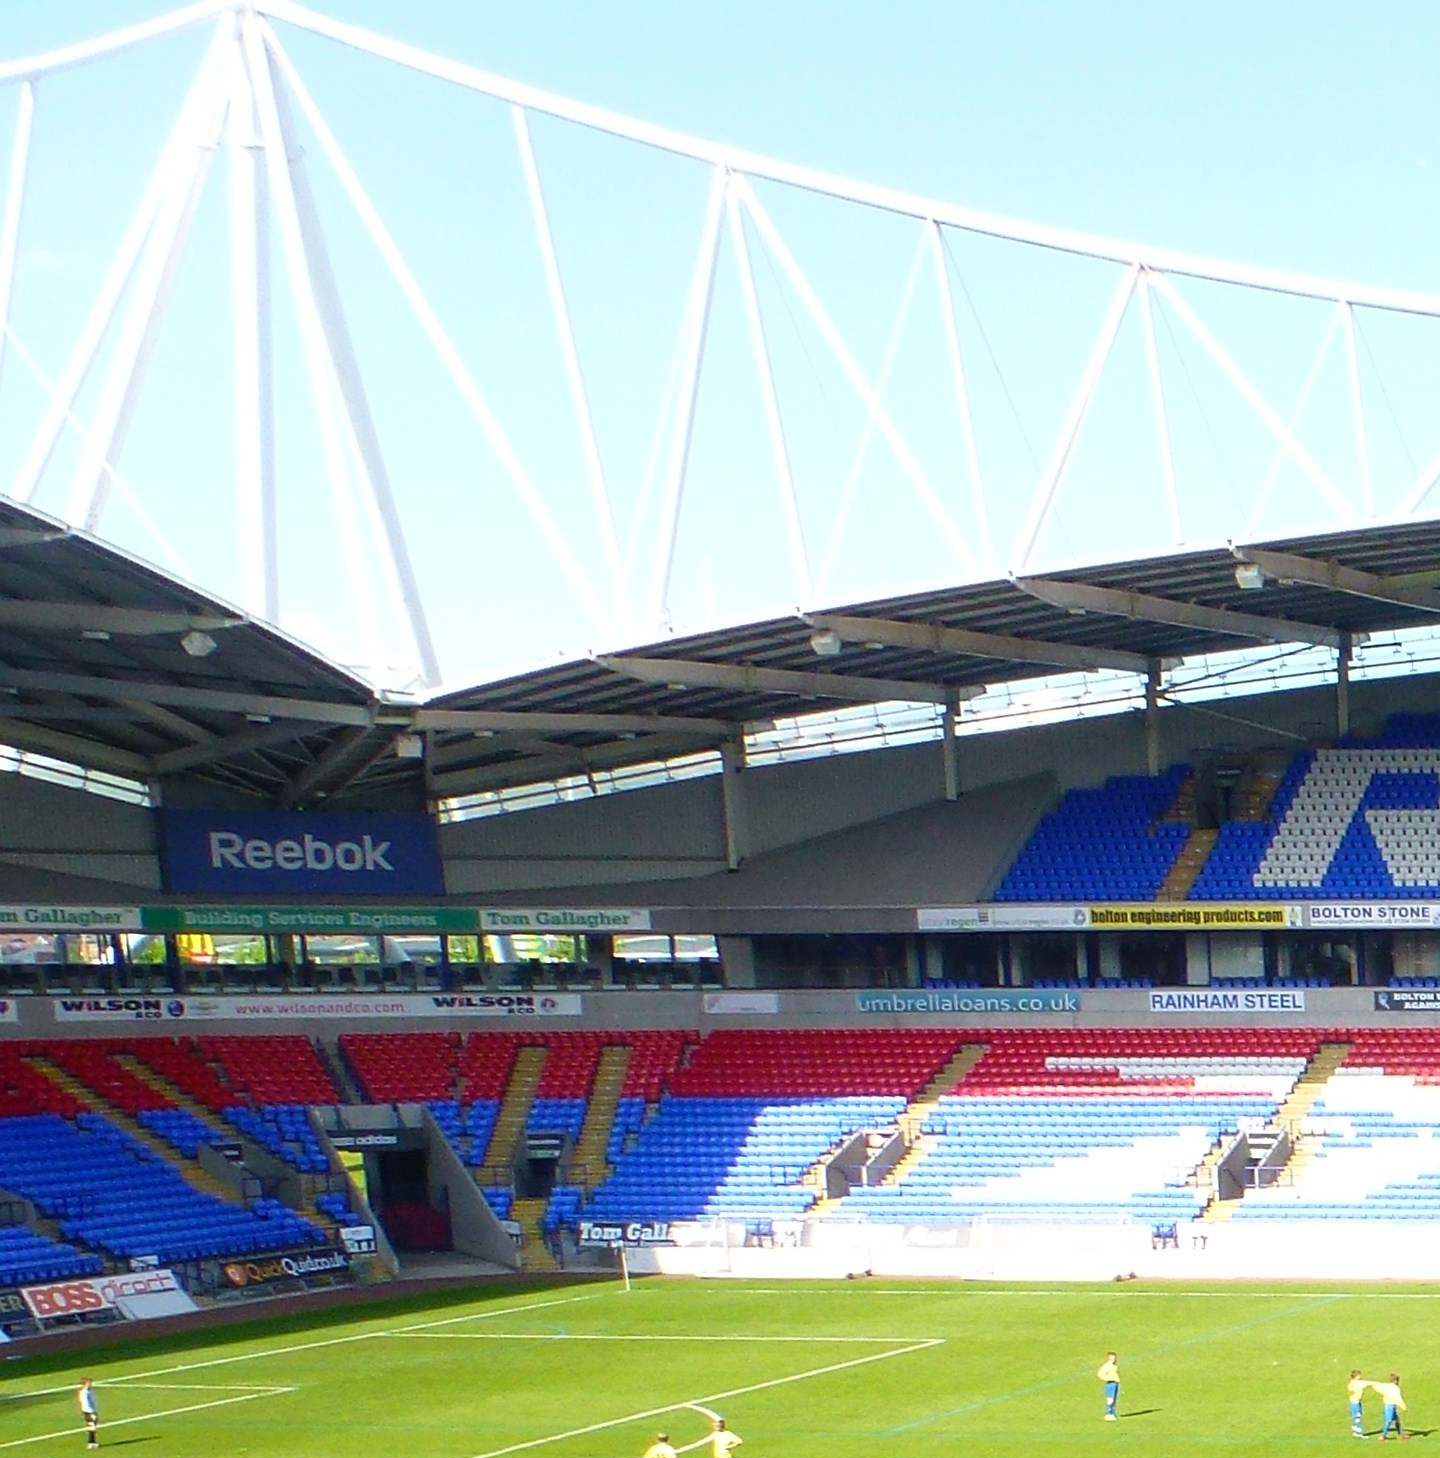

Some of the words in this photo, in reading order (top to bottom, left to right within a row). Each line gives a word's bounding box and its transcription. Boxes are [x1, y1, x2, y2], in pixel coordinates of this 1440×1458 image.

[209, 832, 395, 871] Reebok
[25, 909, 122, 928] Gallagher
[184, 911, 264, 928] Building
[269, 911, 344, 925] Services
[349, 911, 437, 928] Engineers
[487, 912, 530, 925] Tom
[536, 910, 631, 928] Gallagher
[1091, 909, 1128, 923] bolton
[1131, 909, 1201, 925] engineering
[1203, 909, 1284, 925] products.com
[1312, 907, 1373, 918] BOLTON
[1378, 907, 1430, 918] STONE
[859, 993, 1077, 1012] umbrellaloans.co.uk
[1152, 994, 1239, 1009] RAINHAM
[1244, 994, 1302, 1009] STEEL
[1393, 992, 1435, 1001] BOLTON
[235, 1002, 405, 1014] www.wilsonandco.com
[580, 1223, 622, 1240] Tom
[28, 1281, 103, 1316] BOSS
